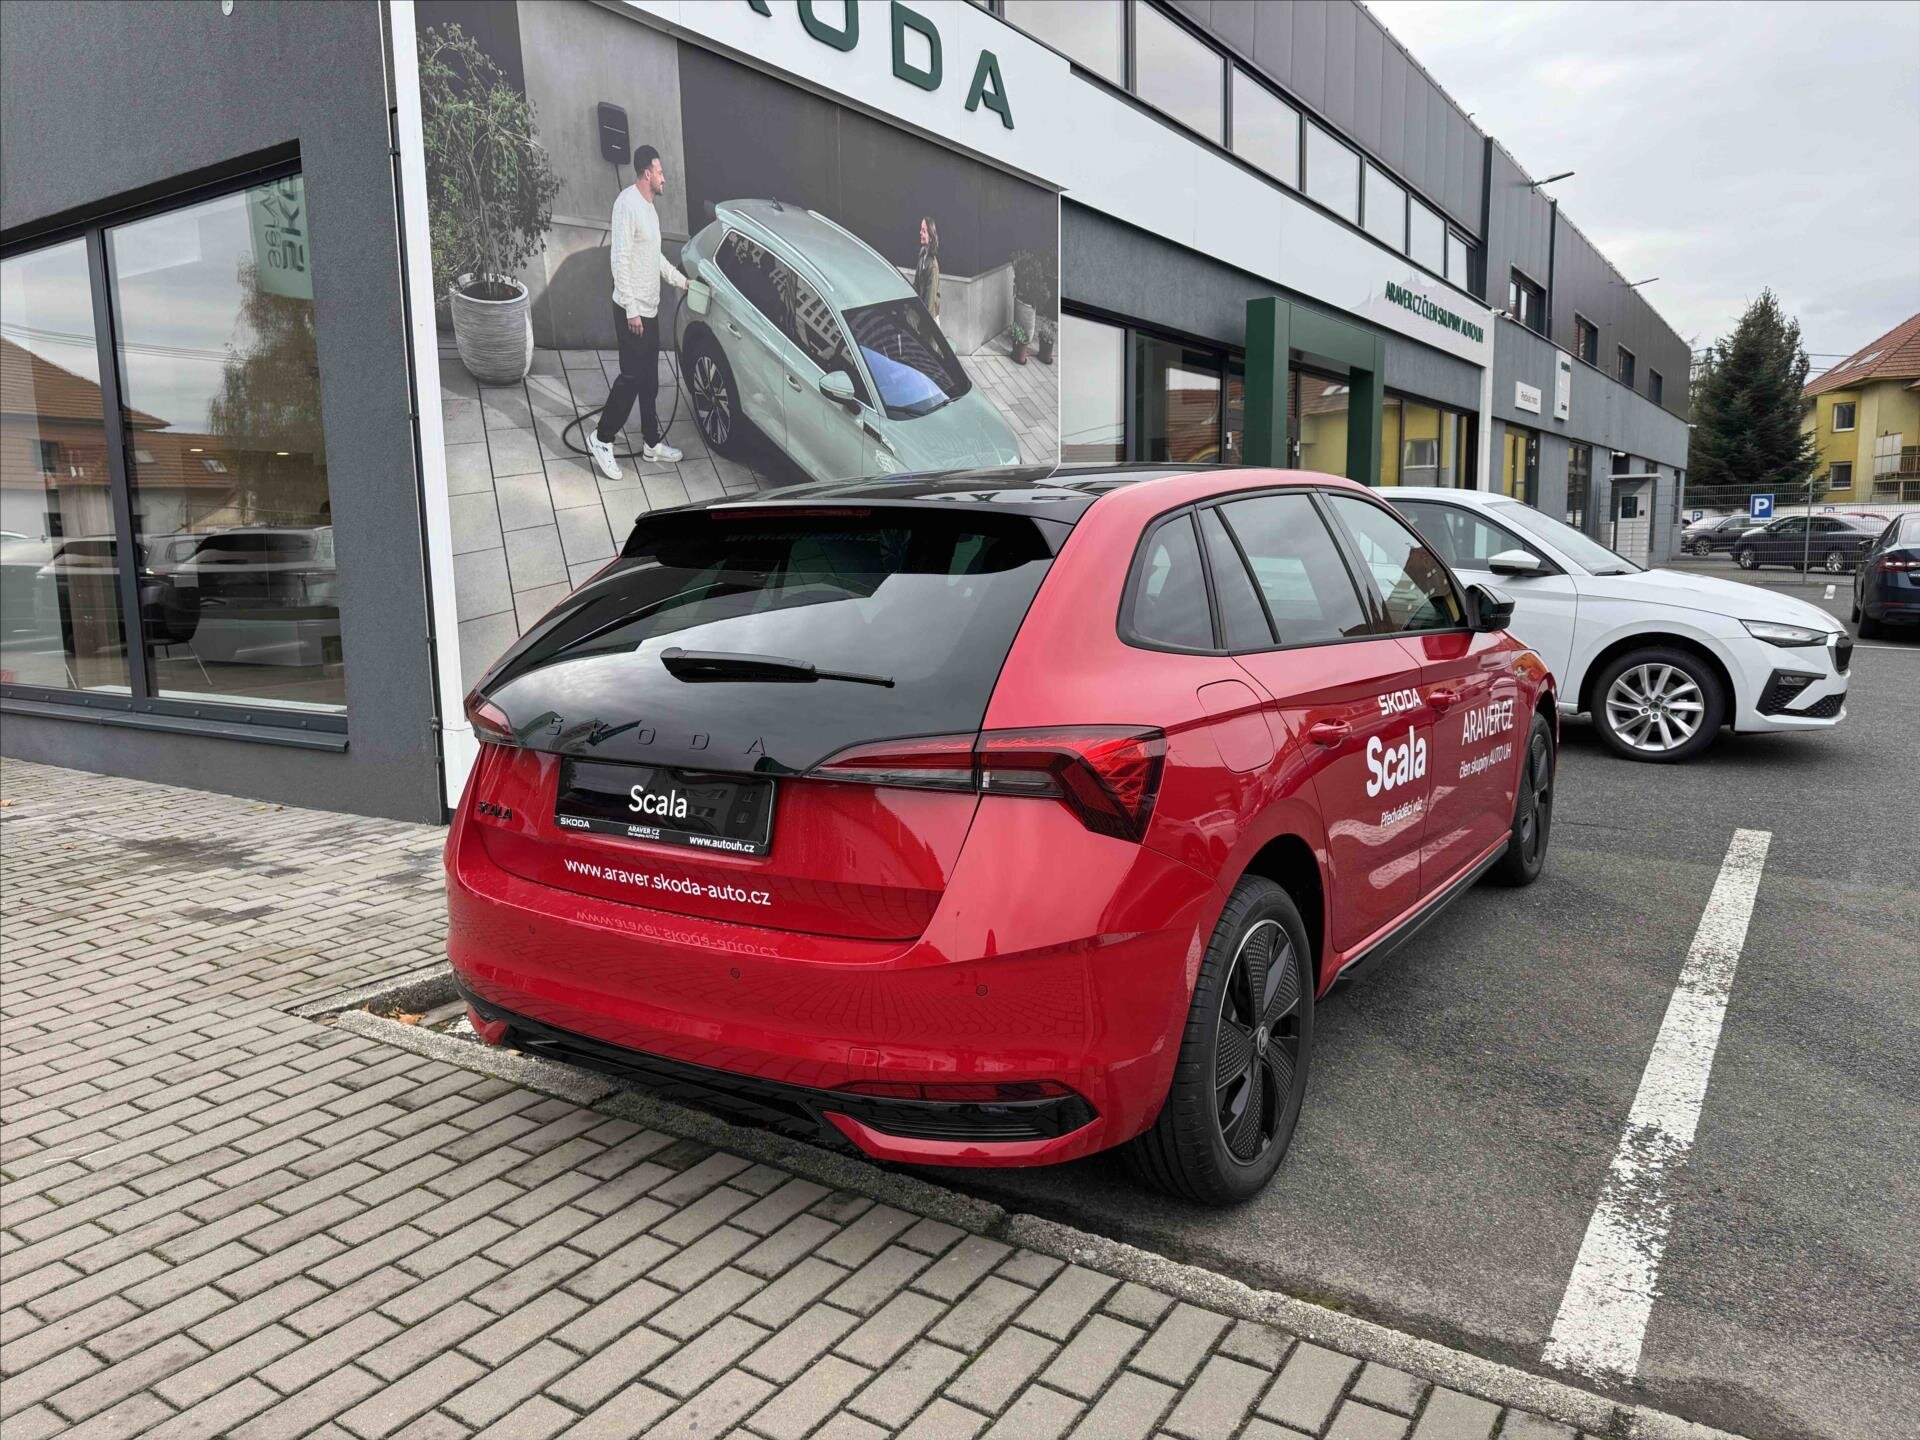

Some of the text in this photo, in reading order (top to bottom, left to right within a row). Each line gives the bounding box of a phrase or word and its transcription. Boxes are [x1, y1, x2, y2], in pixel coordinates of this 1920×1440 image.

[748, 0, 1014, 130] ODA
[1754, 498, 1769, 515] P
[1462, 700, 1514, 746] ARAVER CZ
[1366, 725, 1427, 798] Scala
[628, 784, 688, 819] Scala
[628, 825, 650, 835] ARAVER
[689, 836, 755, 853] www.autouh.cz
[564, 858, 772, 906] www.araver.skoda-auto.cz
